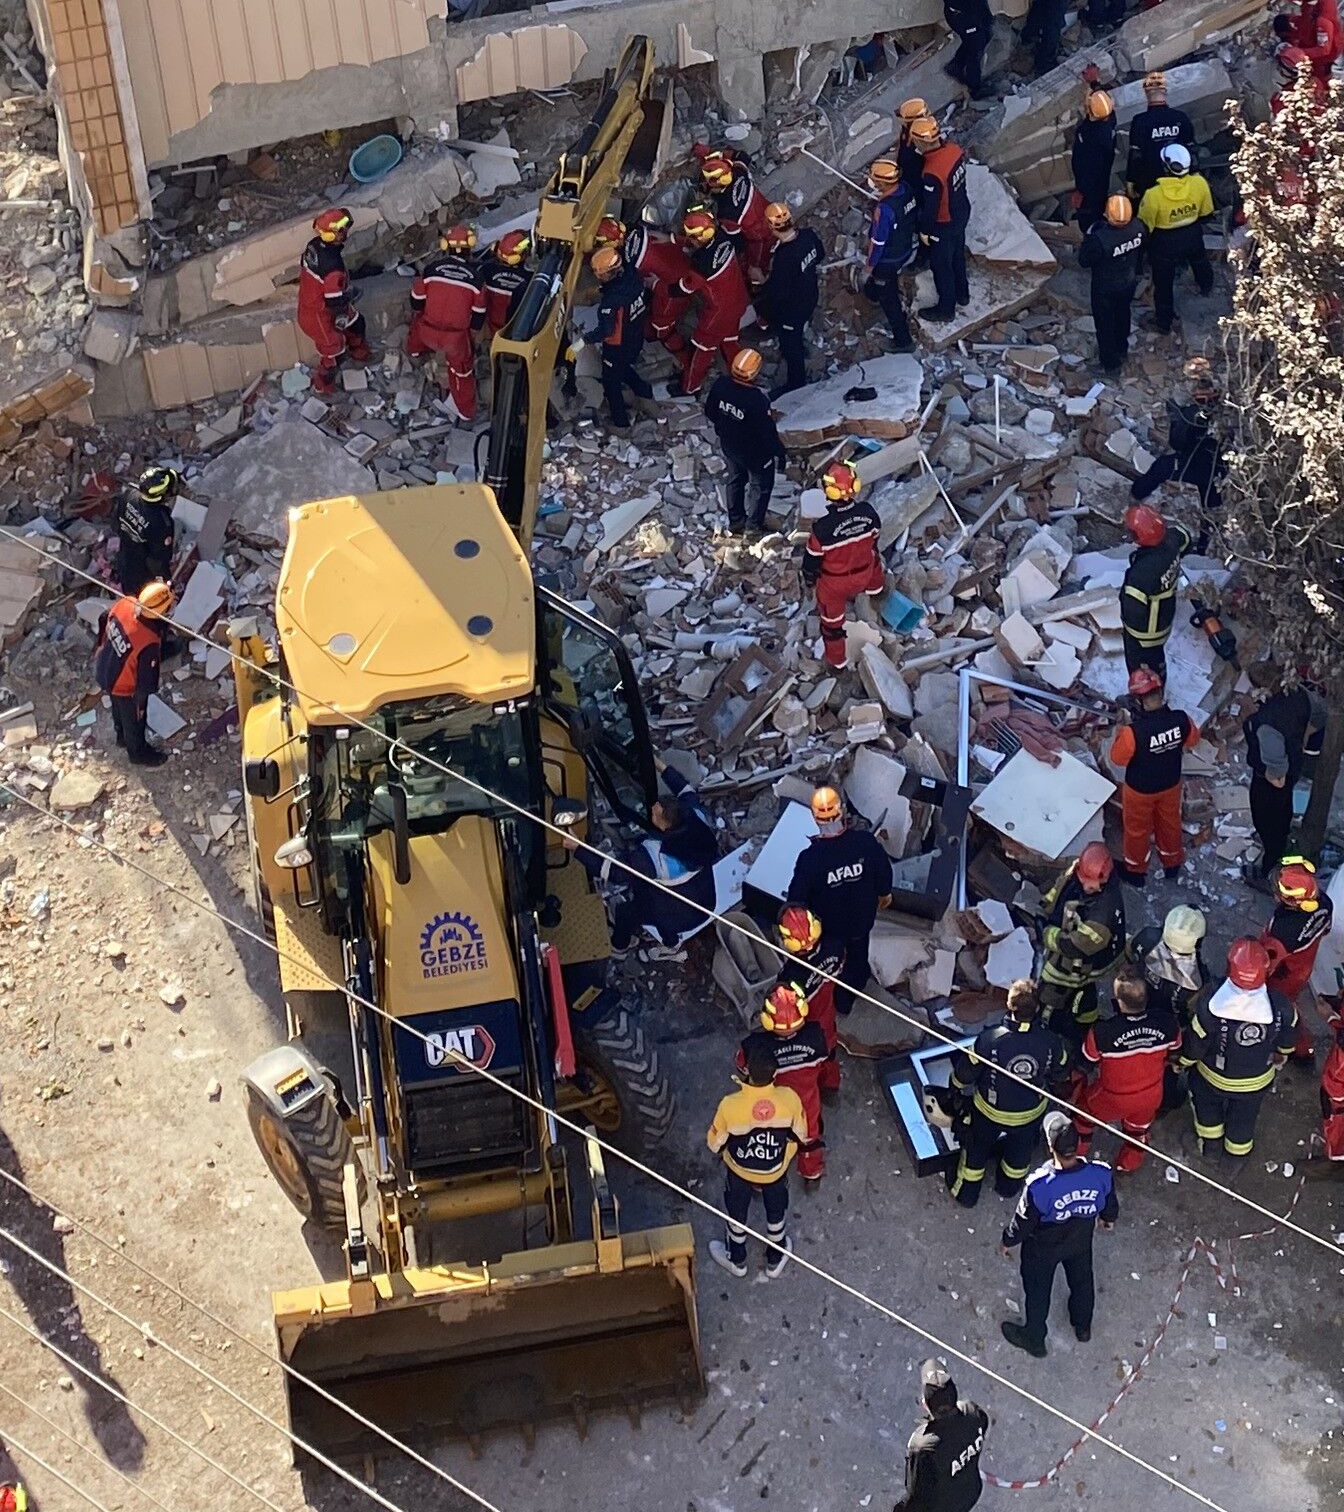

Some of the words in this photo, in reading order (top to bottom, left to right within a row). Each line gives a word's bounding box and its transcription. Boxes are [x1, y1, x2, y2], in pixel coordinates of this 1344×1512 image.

[1152, 126, 1179, 139] AFAD
[1113, 237, 1142, 257] AFAD
[719, 400, 745, 420] AFAD
[1150, 727, 1181, 748] ARTE
[827, 863, 863, 884] AFAD
[421, 941, 487, 967] GEBZE
[423, 959, 489, 979] BELEDİYESİ
[426, 1028, 475, 1067] CAT
[747, 1131, 779, 1148] ACİL
[736, 1145, 782, 1160] SAĞLI
[1054, 1190, 1099, 1210] GEBZE
